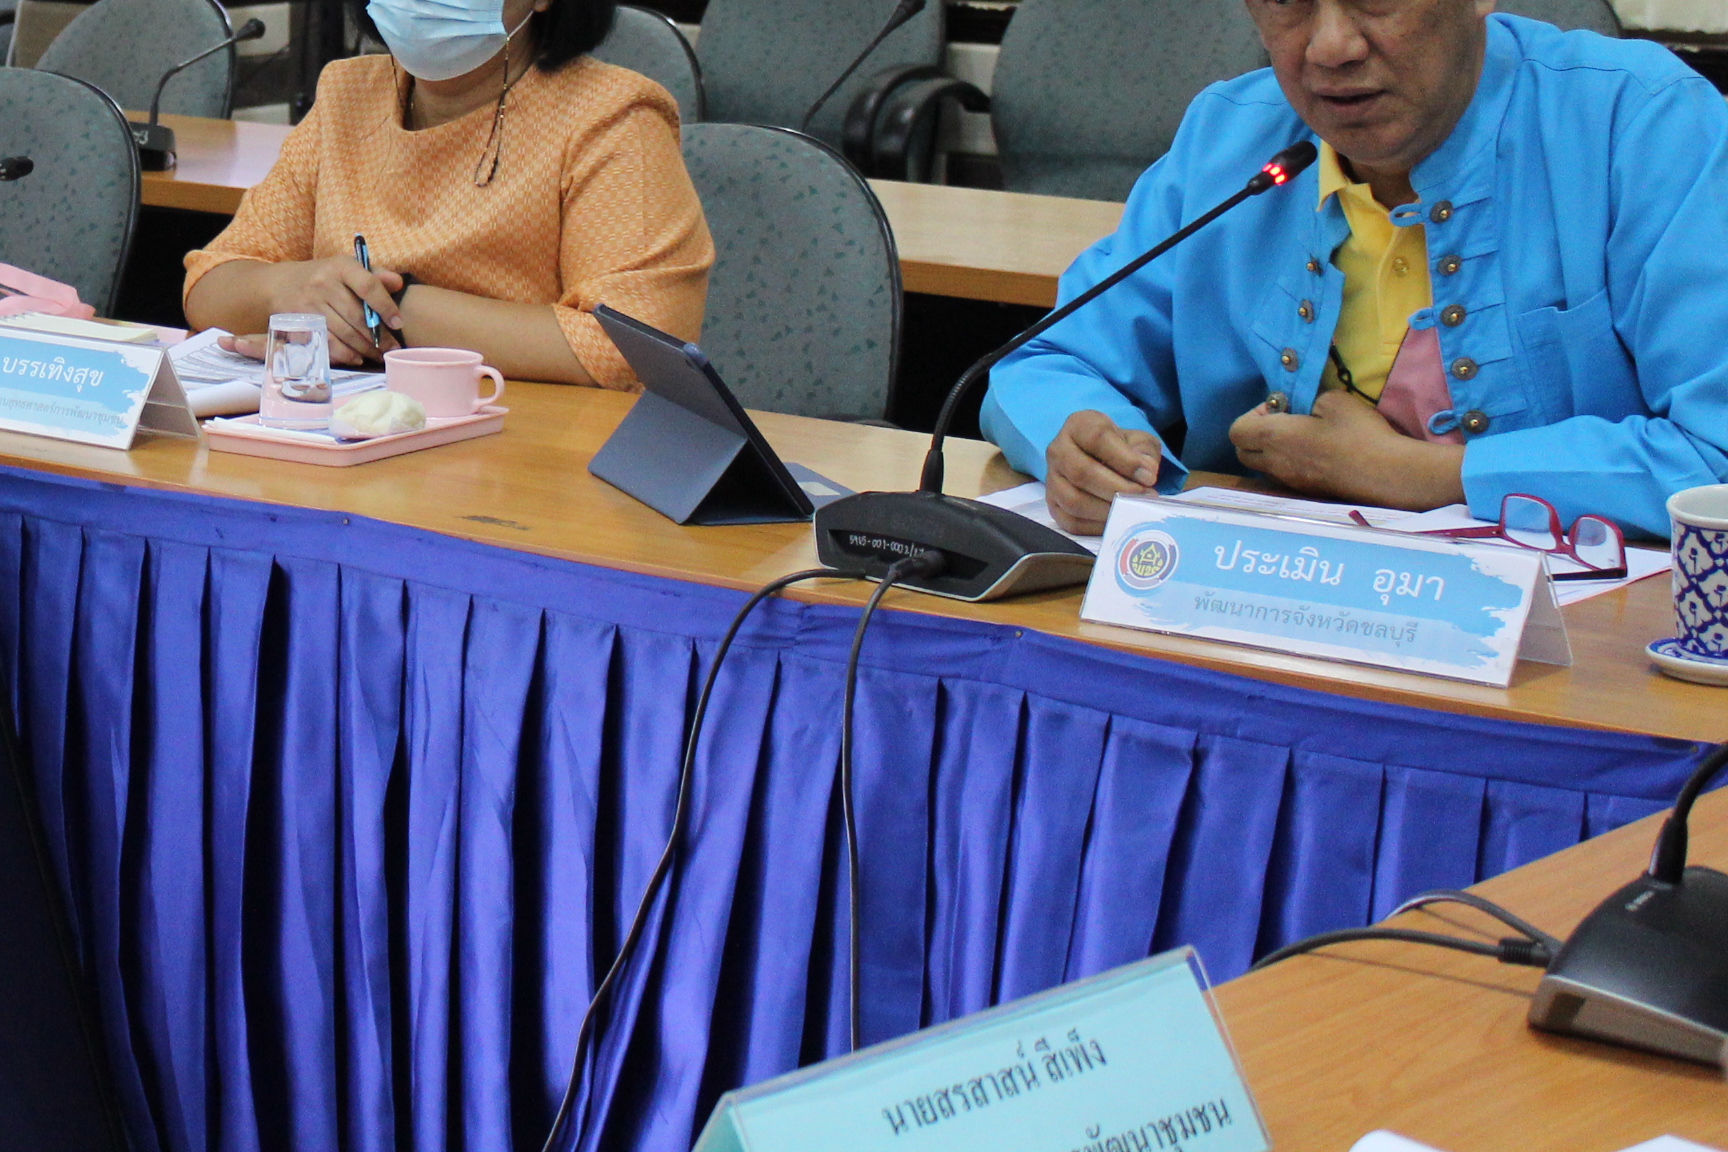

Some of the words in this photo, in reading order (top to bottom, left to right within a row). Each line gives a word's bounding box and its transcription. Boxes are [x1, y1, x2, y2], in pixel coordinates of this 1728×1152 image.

[2, 355, 105, 394] บรรเทิงสุข
[1214, 539, 1346, 586] ประเมิน
[1372, 568, 1446, 606] อุมา
[1194, 591, 1419, 648] พัฒนาการจังหวัดชลบุรี
